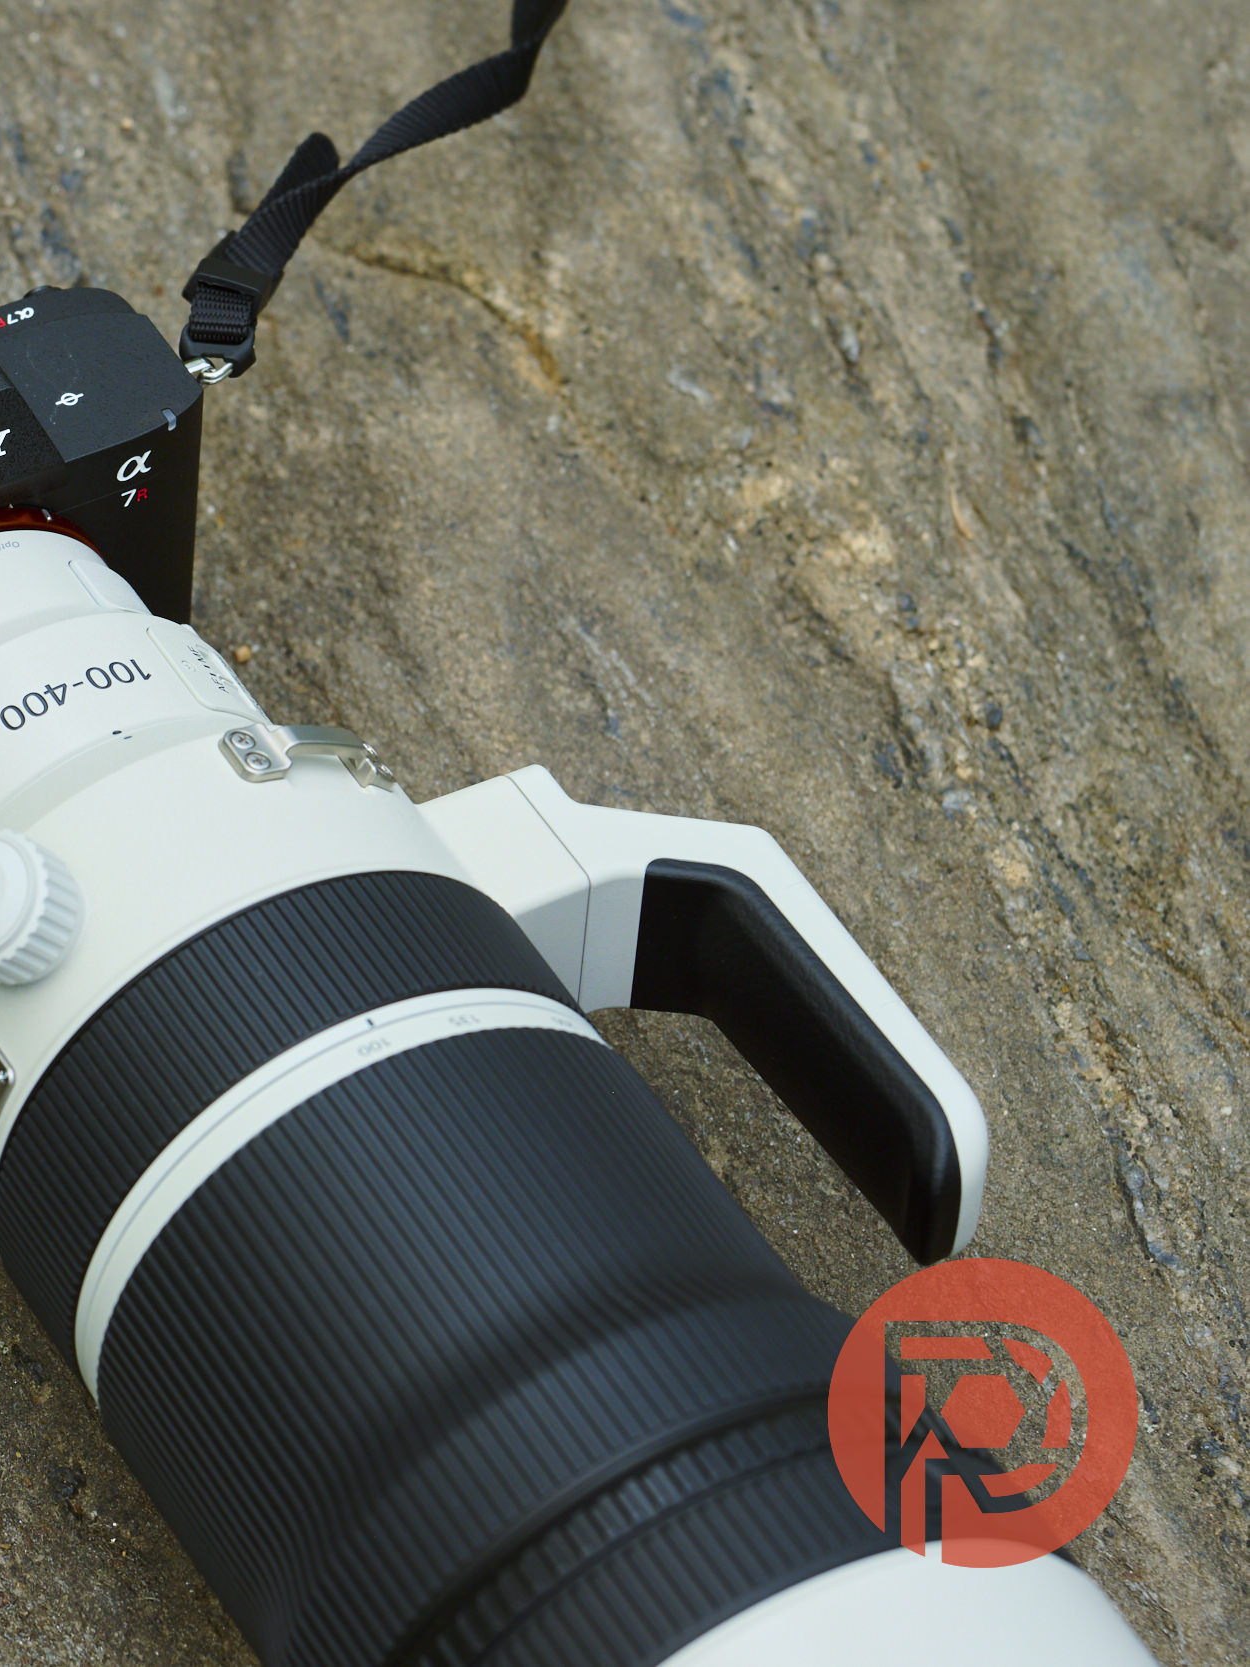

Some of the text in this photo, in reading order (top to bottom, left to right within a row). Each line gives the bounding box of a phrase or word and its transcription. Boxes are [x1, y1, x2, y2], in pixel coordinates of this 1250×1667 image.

[120, 487, 148, 507] 7R
[0, 658, 152, 731] 100-400
[357, 1036, 392, 1058] 100
